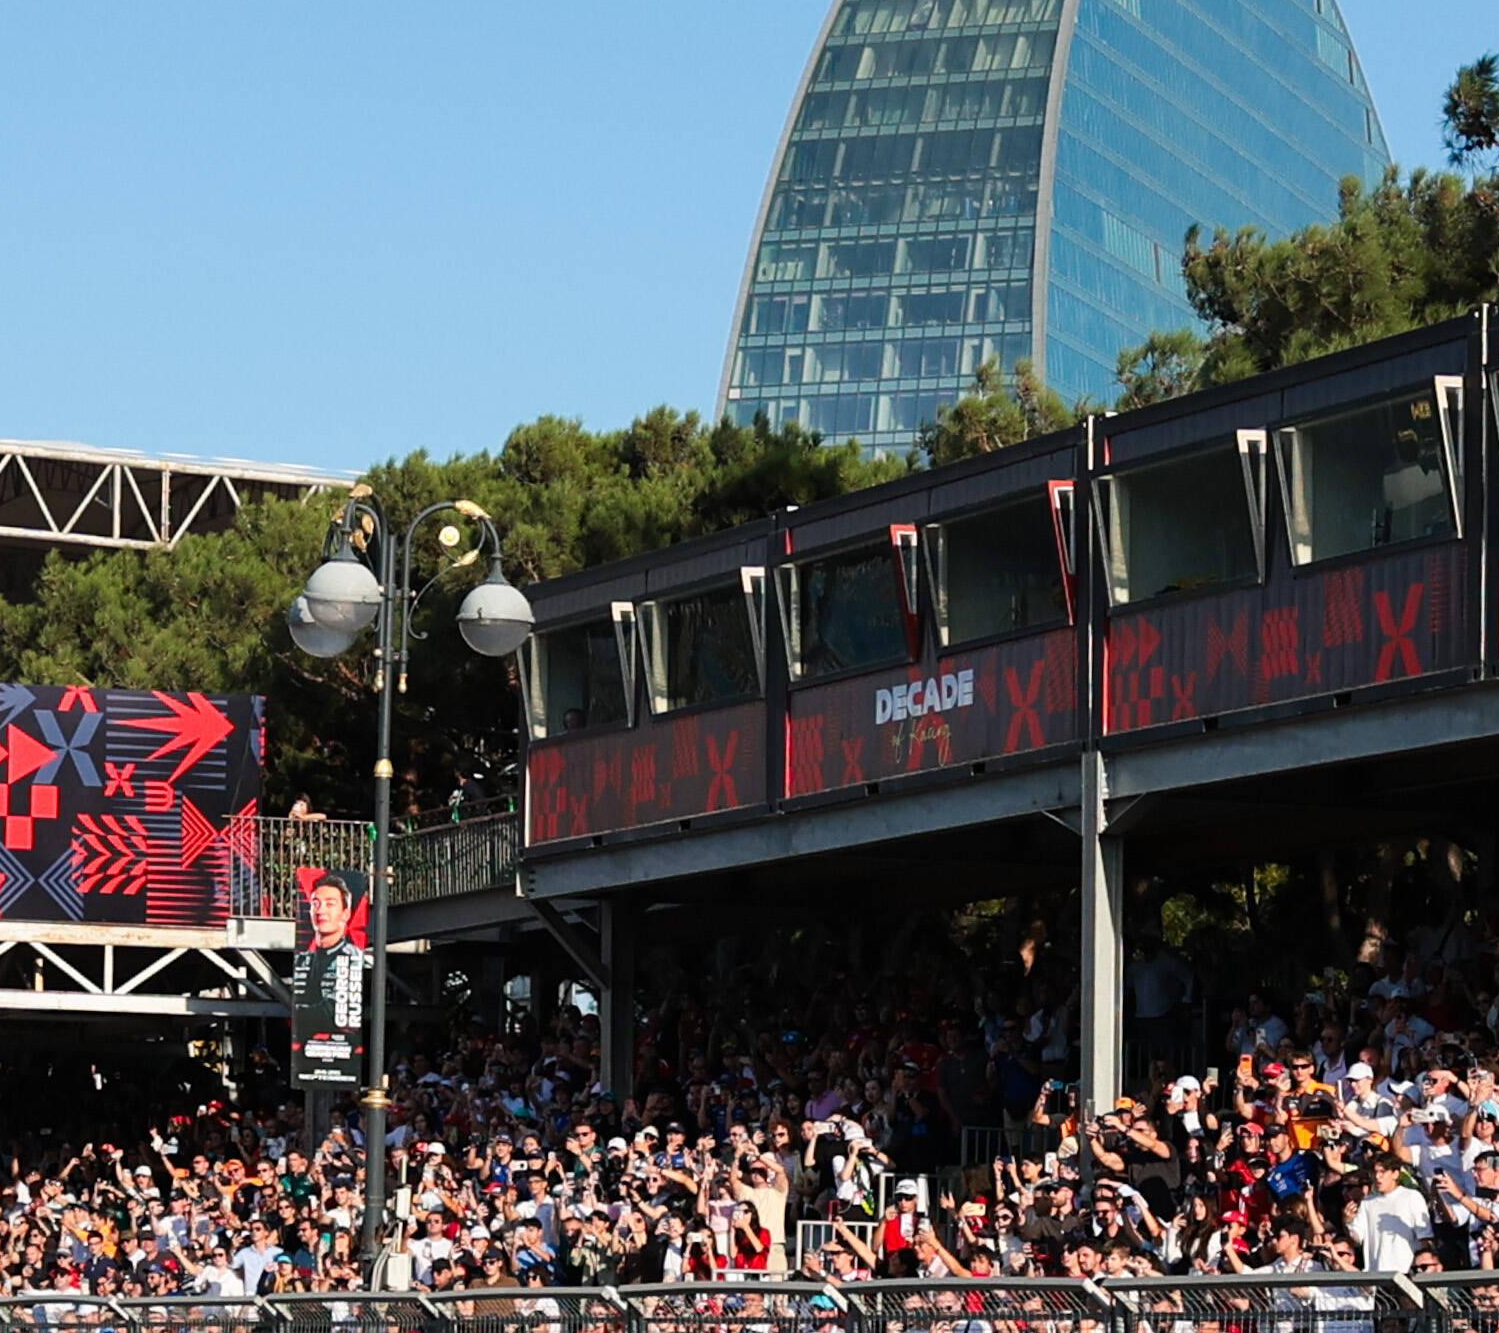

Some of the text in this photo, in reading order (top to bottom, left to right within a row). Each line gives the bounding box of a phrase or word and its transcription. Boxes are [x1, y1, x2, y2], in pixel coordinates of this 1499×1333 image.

[875, 669, 974, 725] DECADE
[335, 955, 349, 1027] GEORGE
[348, 953, 363, 1028] RUSSELL
